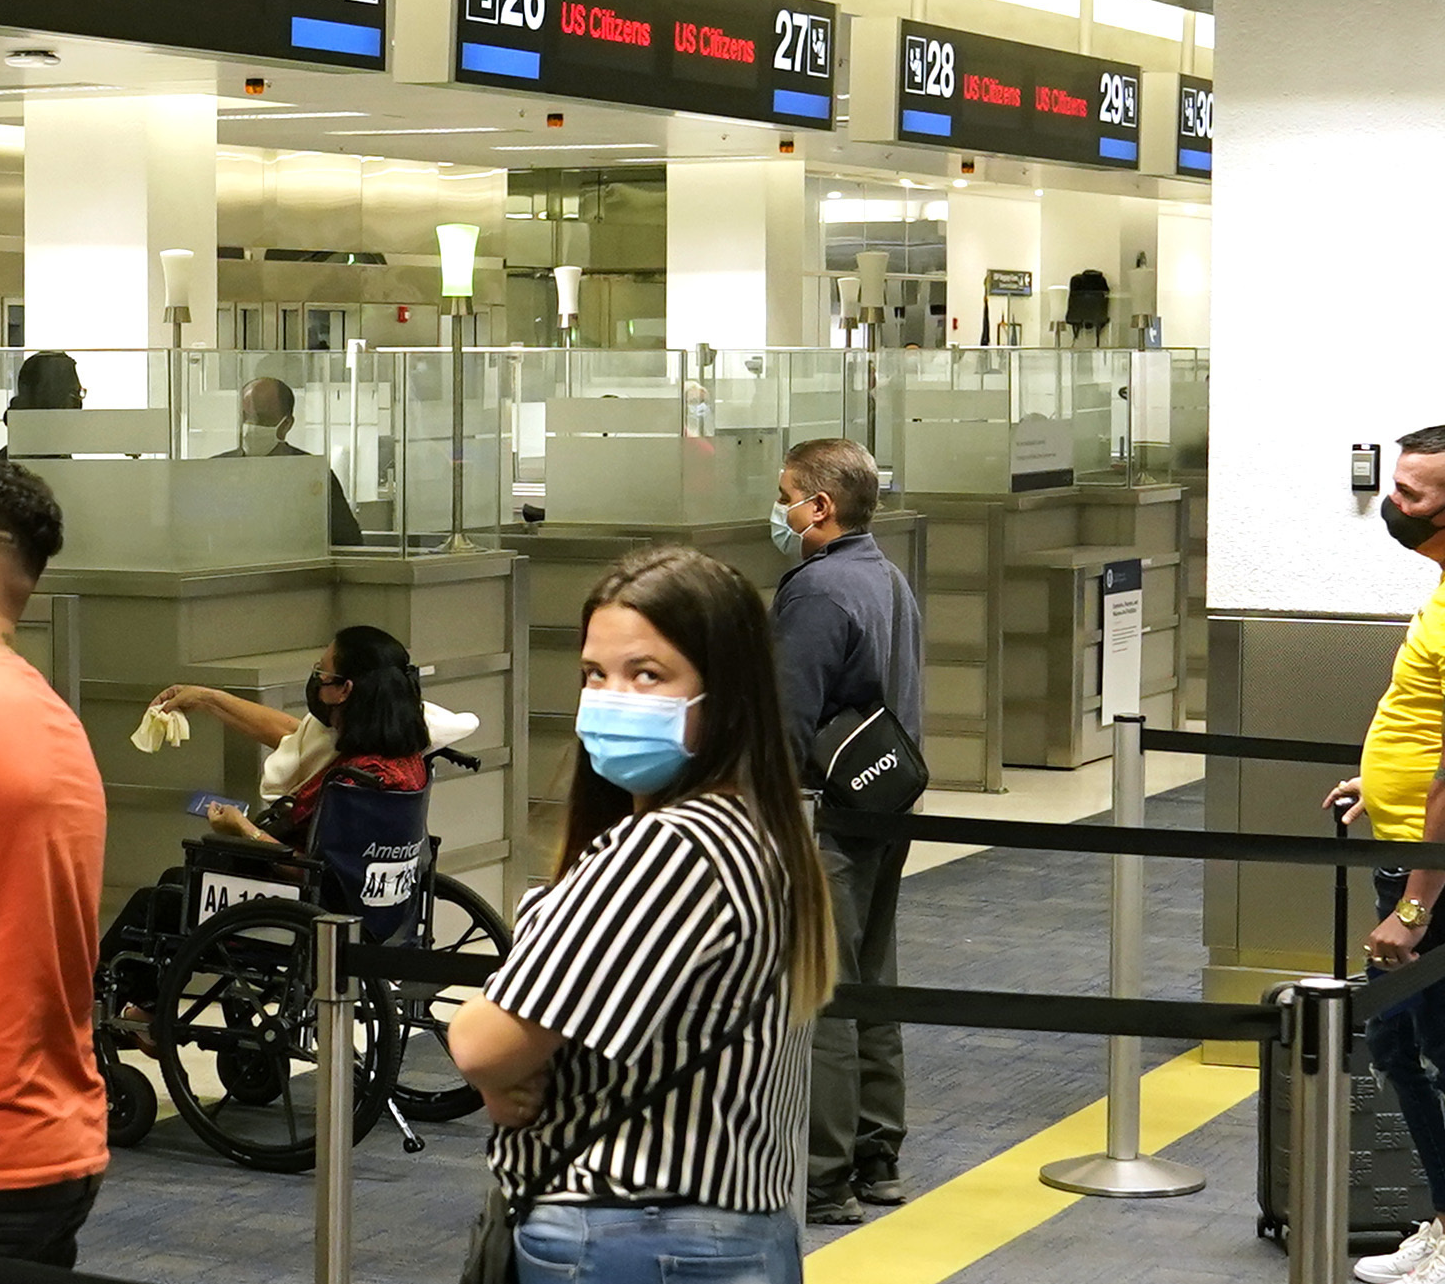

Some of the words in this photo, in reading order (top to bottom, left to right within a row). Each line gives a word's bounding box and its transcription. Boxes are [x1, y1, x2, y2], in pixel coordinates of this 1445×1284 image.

[561, 1, 587, 36] US
[589, 7, 651, 47] Citizens
[674, 21, 698, 54] US
[700, 26, 755, 64] Citizens
[773, 9, 808, 72] 27
[926, 40, 955, 99] 28
[963, 73, 980, 101] US
[981, 77, 1021, 107] Citizens
[1035, 85, 1050, 111] US
[1051, 88, 1088, 118] Citizens
[1099, 72, 1123, 124] 29
[850, 752, 897, 791] envoy
[205, 884, 229, 913] AA
[362, 871, 387, 898] AA
